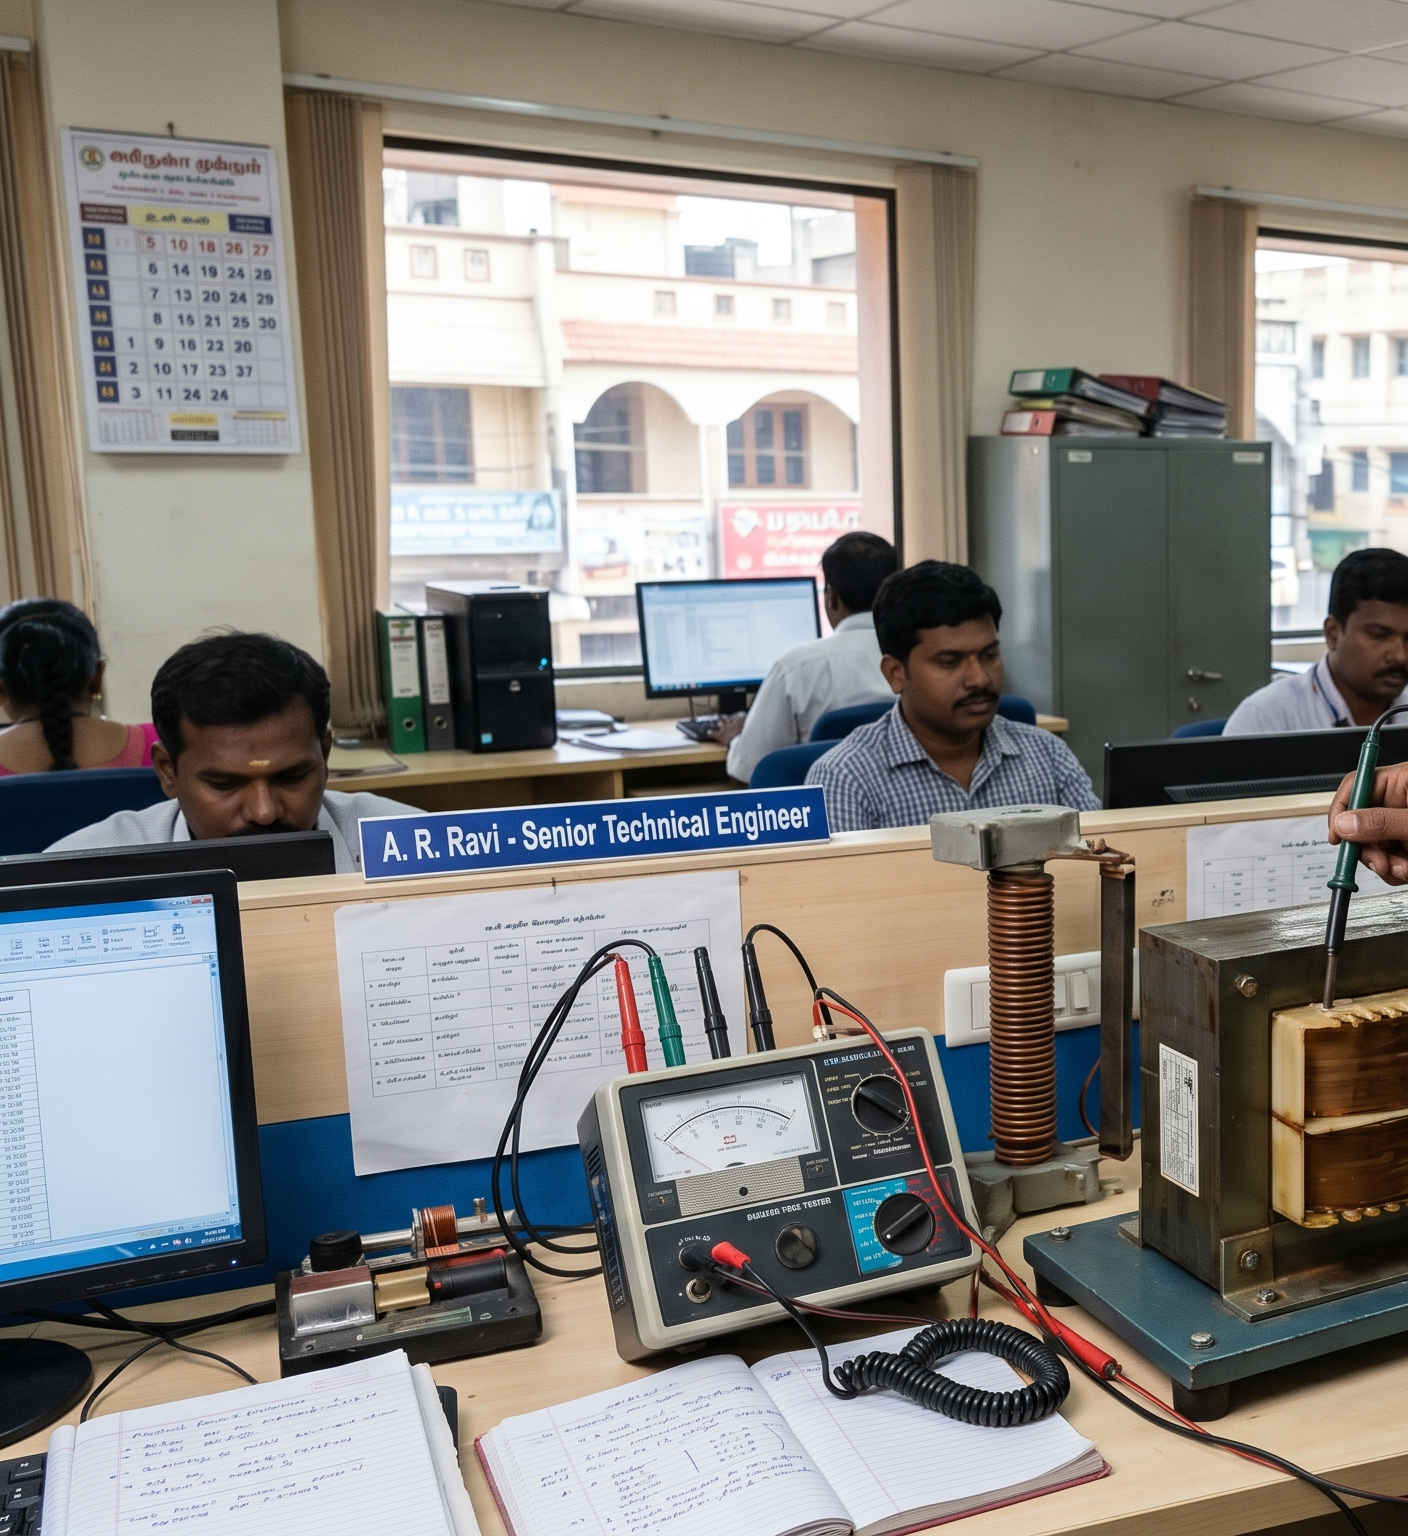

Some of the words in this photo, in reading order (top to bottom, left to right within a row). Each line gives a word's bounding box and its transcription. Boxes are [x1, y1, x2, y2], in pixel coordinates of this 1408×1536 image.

[147, 237, 156, 249] 5
[171, 238, 188, 251] 10
[225, 242, 244, 255] 26
[253, 244, 269, 256] 27
[201, 265, 218, 278] 19
[227, 266, 245, 279] 24
[151, 287, 159, 299] 7
[202, 290, 221, 303] 20
[229, 292, 247, 304] 24
[257, 293, 274, 306] 29
[204, 315, 221, 327] 21
[232, 316, 250, 329] 25
[258, 317, 276, 330] 30
[127, 336, 134, 348] 1
[154, 338, 164, 350] 9
[129, 362, 139, 374] 2
[153, 363, 171, 375] 10
[182, 364, 199, 376] 17
[209, 365, 227, 377] 23
[131, 387, 141, 400] 3
[156, 388, 172, 400] 11
[183, 388, 201, 400] 24
[210, 389, 229, 401] 24
[382, 831, 408, 863] A.
[414, 828, 441, 860] R.
[446, 823, 500, 857] Ravi
[507, 837, 516, 845] -
[521, 817, 597, 851] Senior
[602, 807, 710, 844] Technical
[715, 803, 811, 841] Engineer
